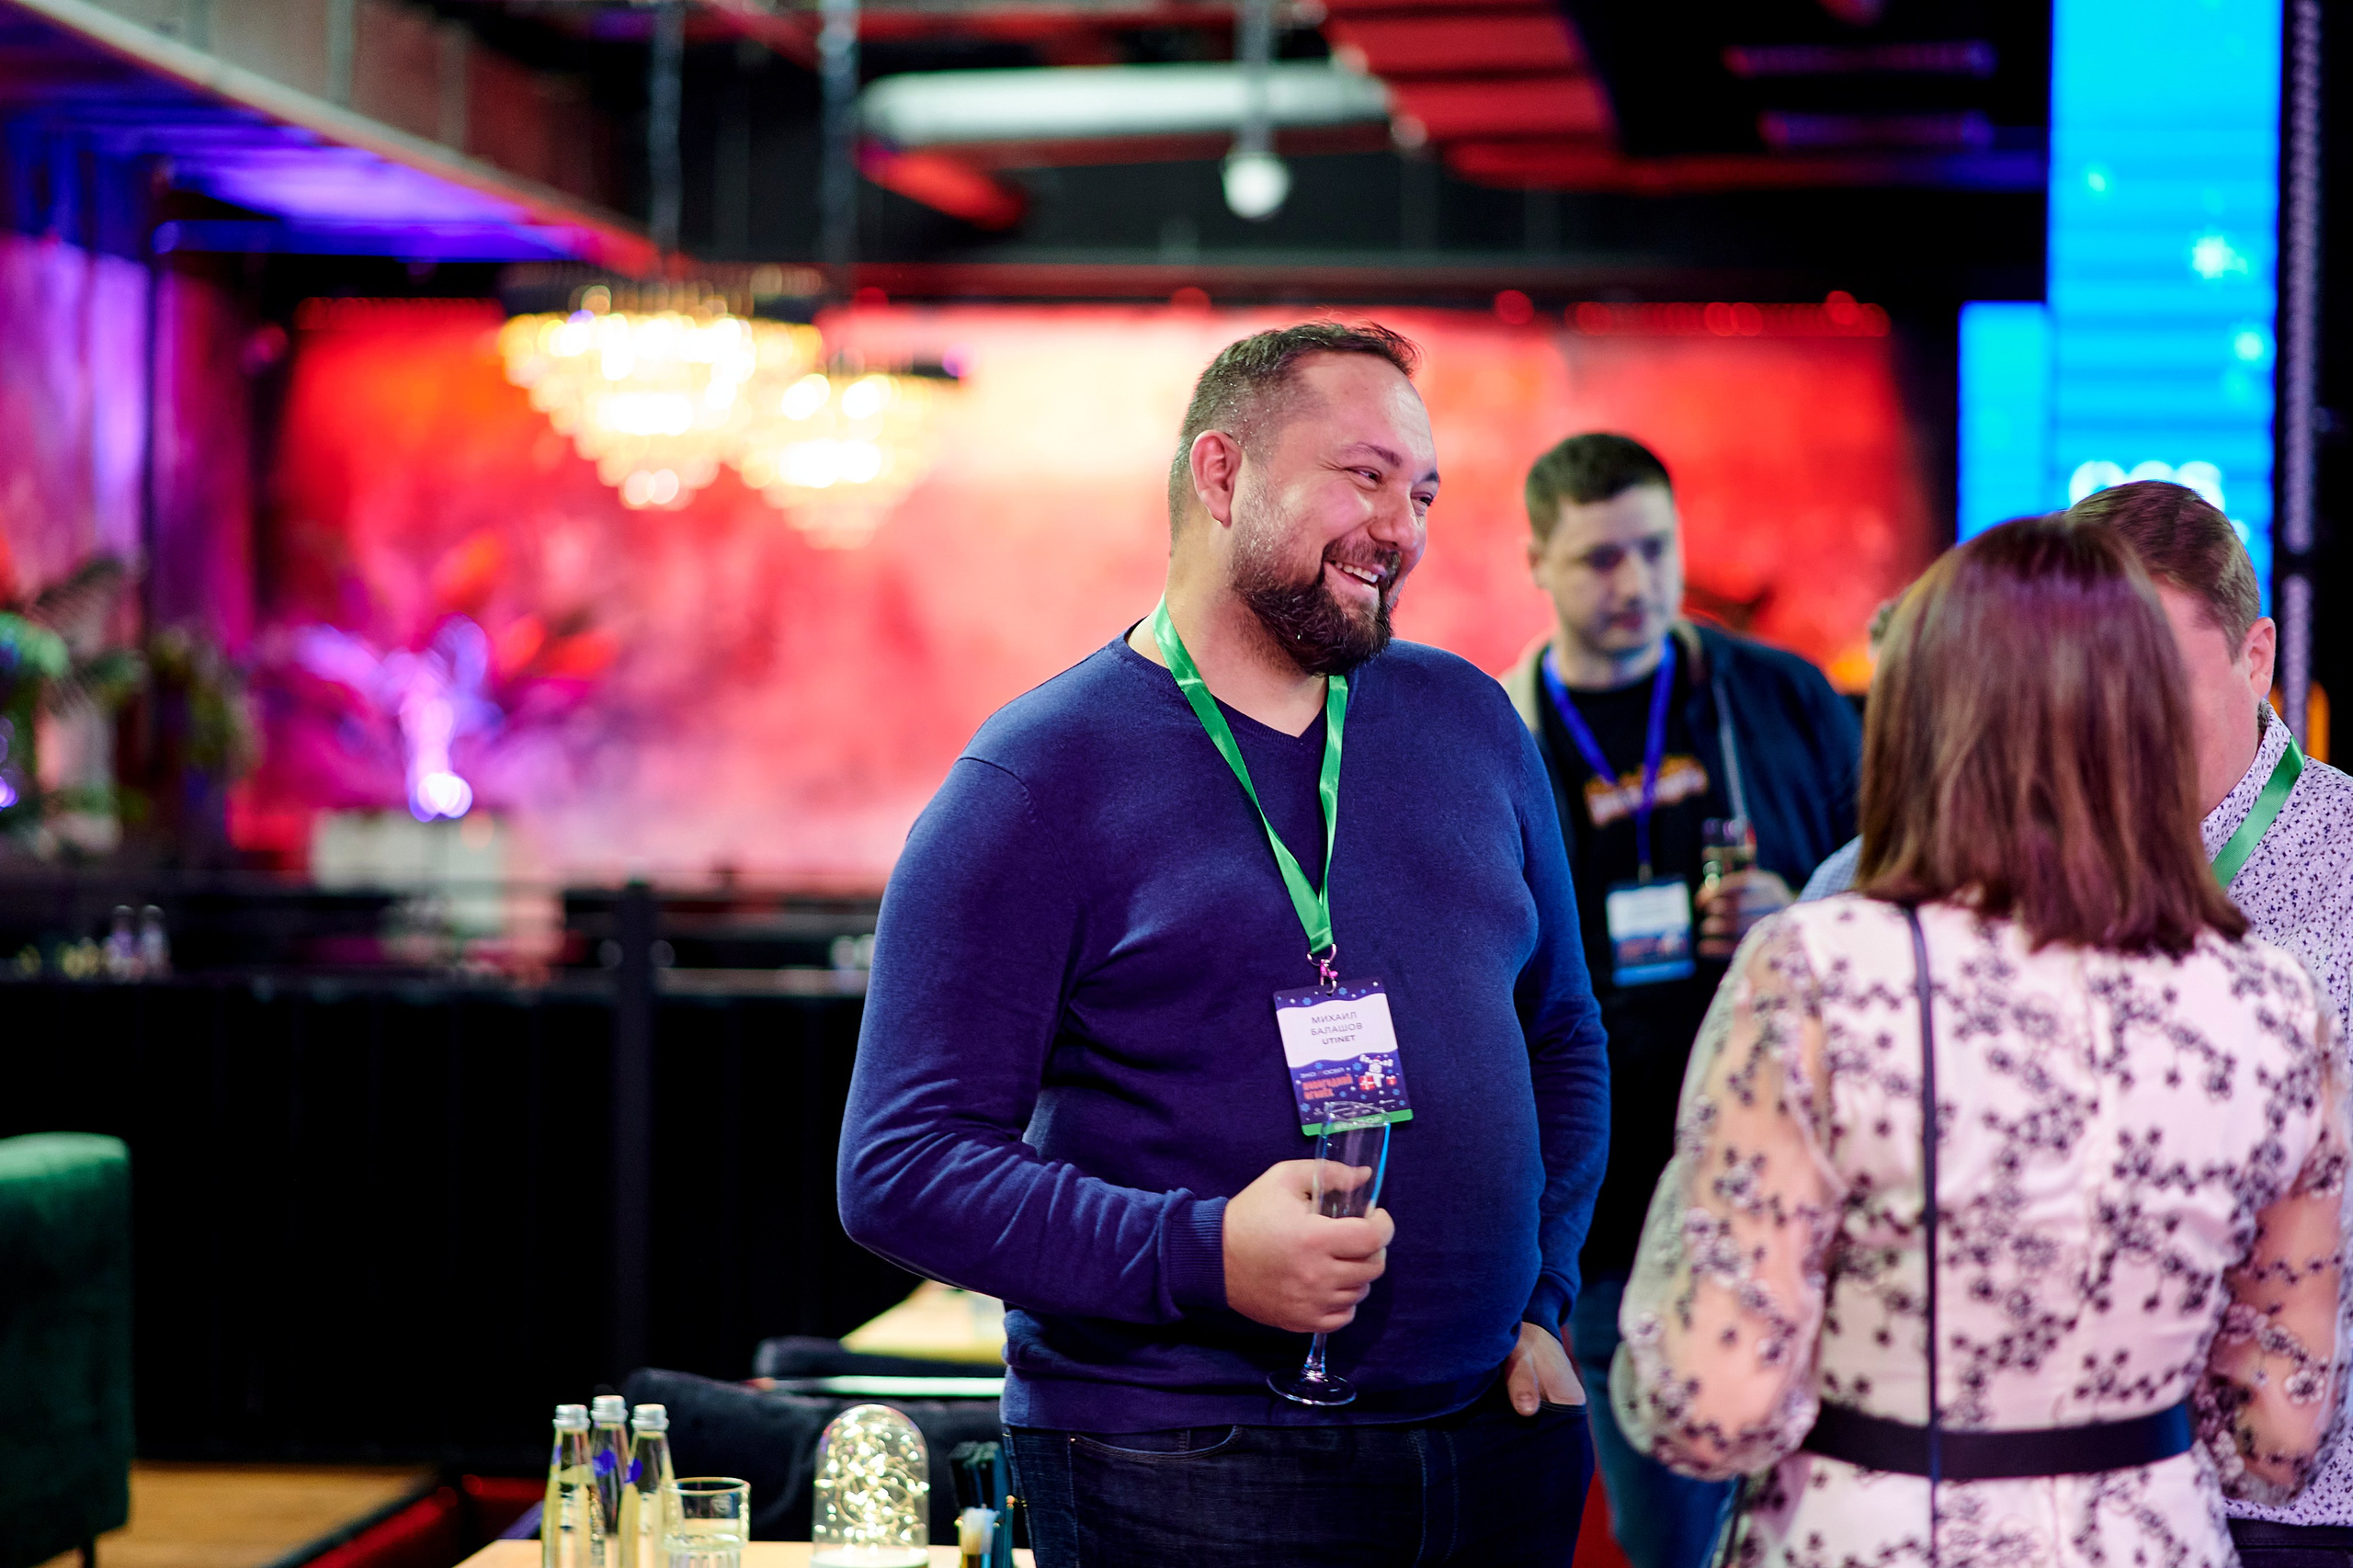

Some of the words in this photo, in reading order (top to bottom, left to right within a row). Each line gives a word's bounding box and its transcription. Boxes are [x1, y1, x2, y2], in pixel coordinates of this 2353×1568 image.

[1312, 1012, 1358, 1024] МИХАИЛ
[1311, 1022, 1363, 1036] БАЛАШОВ
[1322, 1035, 1356, 1045] UTINET
